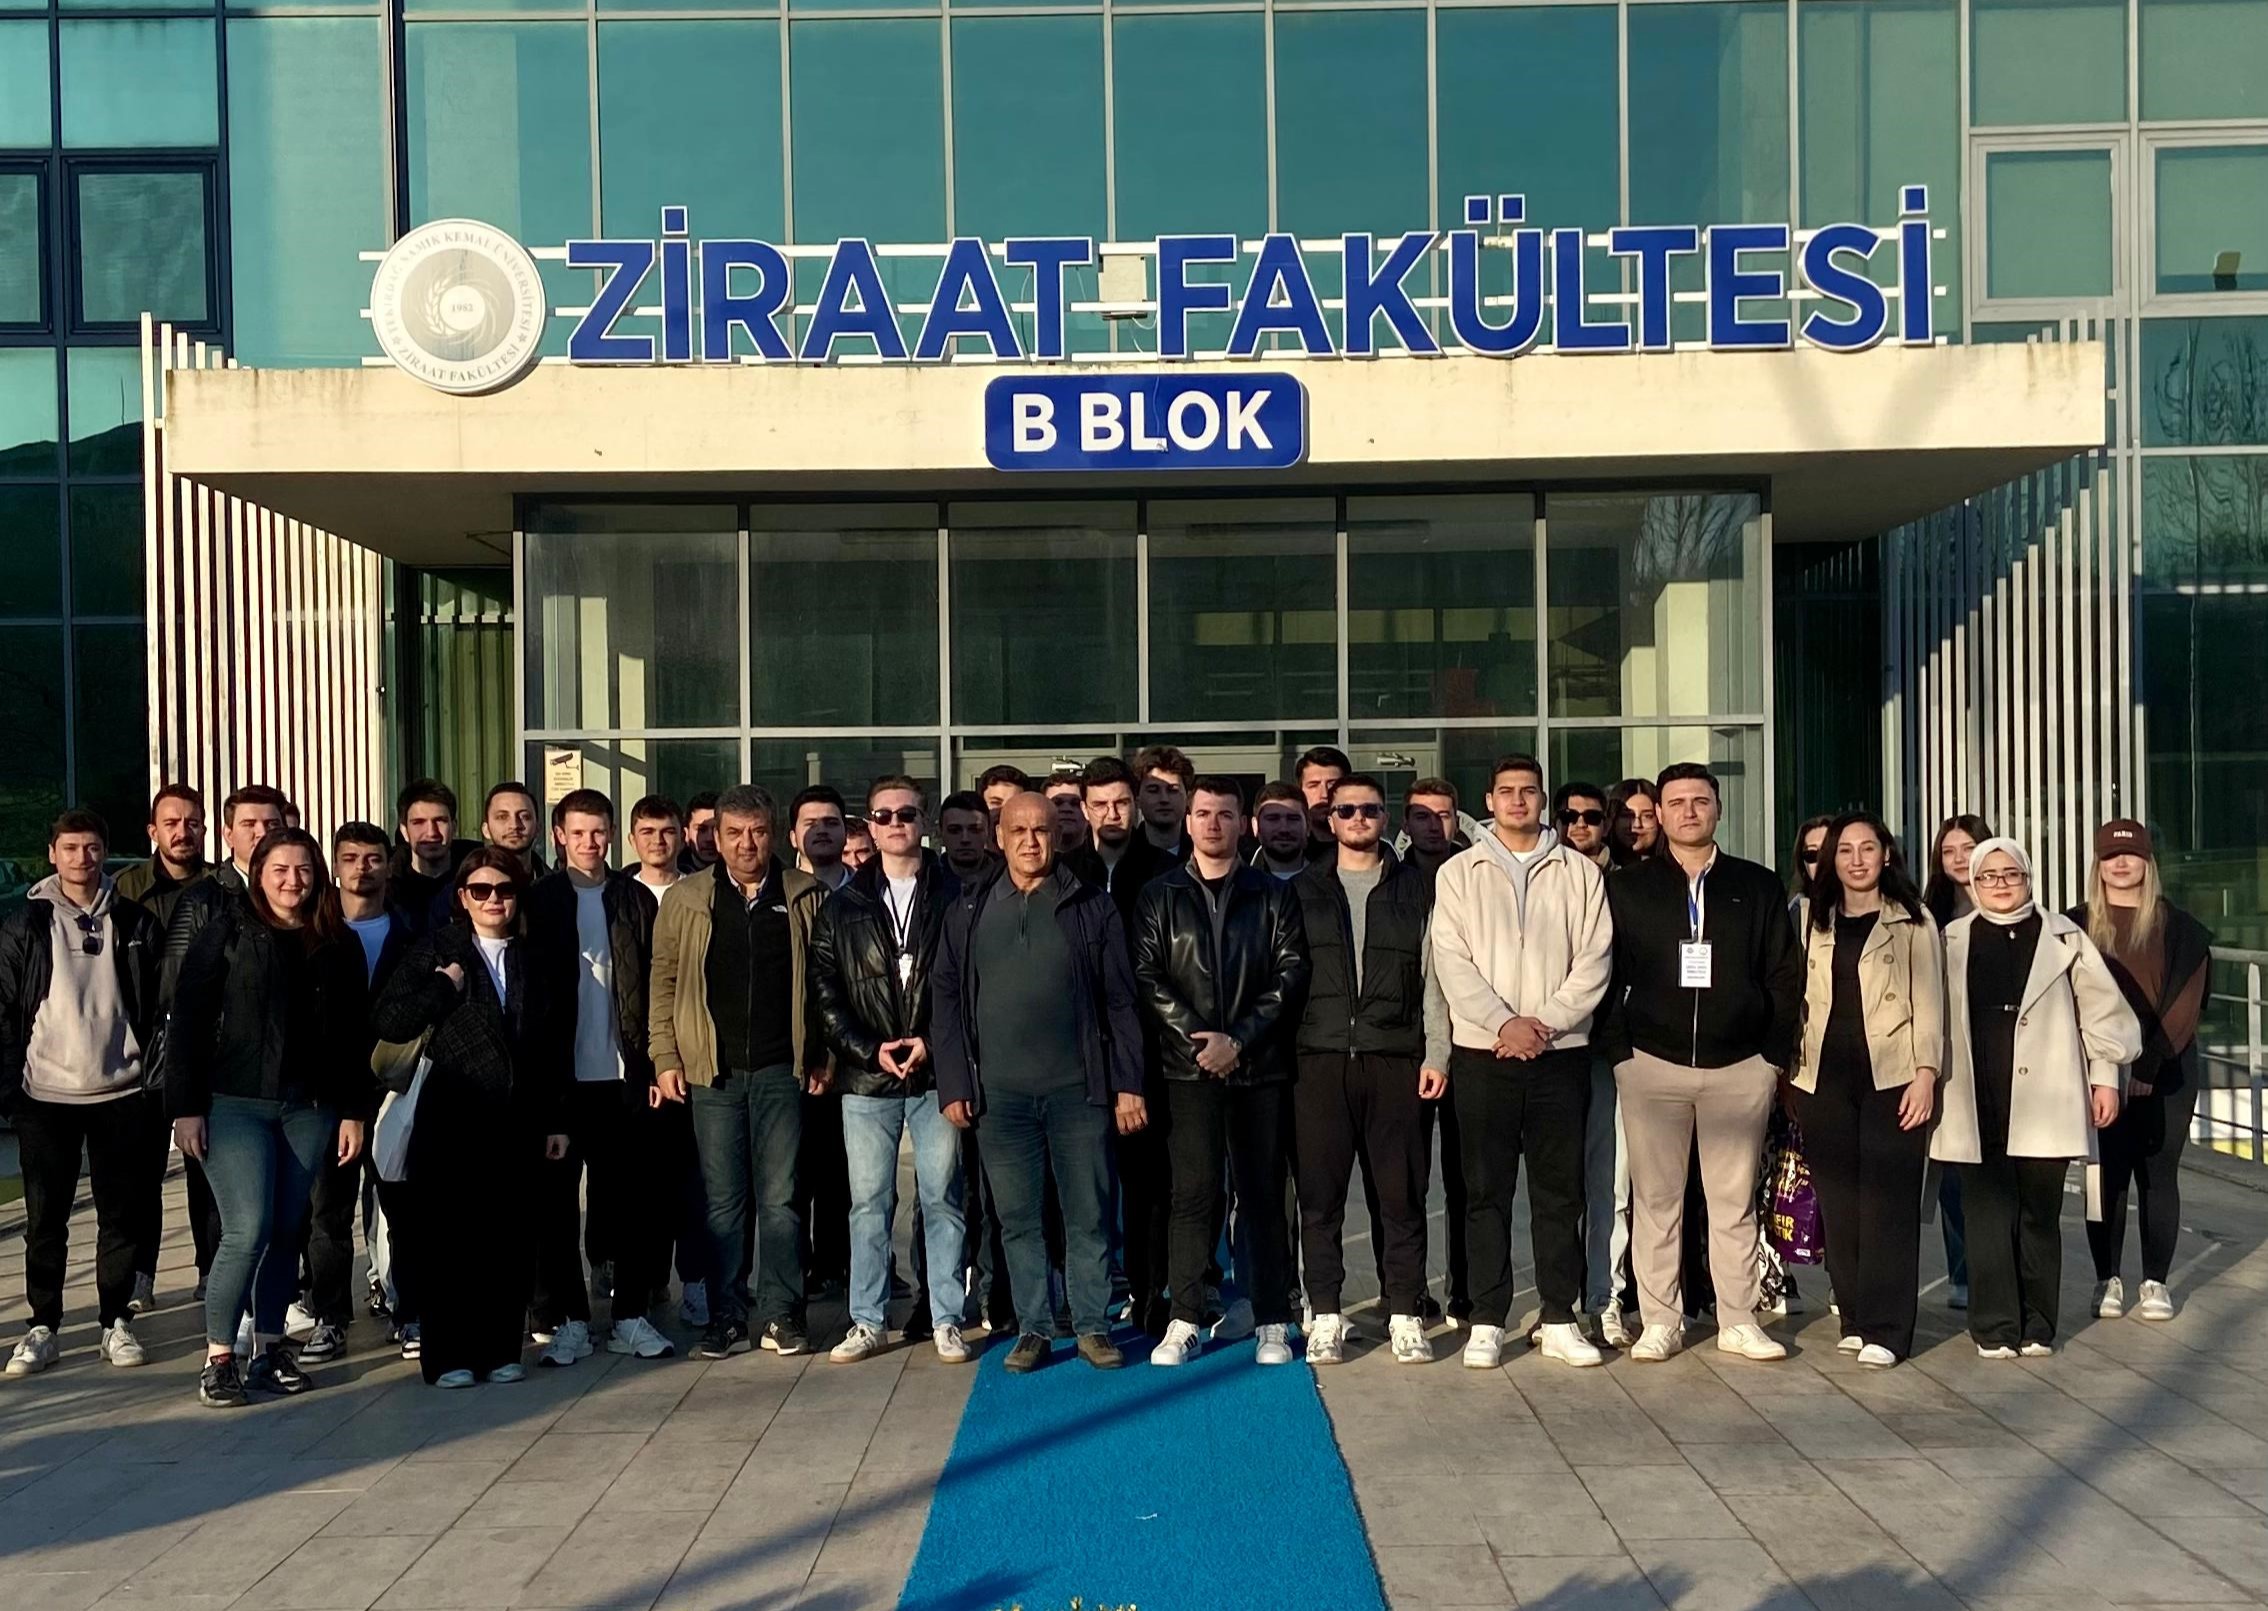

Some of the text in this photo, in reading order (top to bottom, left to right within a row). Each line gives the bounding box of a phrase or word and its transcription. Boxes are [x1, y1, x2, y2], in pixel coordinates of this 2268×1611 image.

[565, 184, 1933, 363] ZİRAAT FAKÜLTESİ
[450, 303, 474, 313] 1982
[1012, 390, 1274, 453] B BLOK
